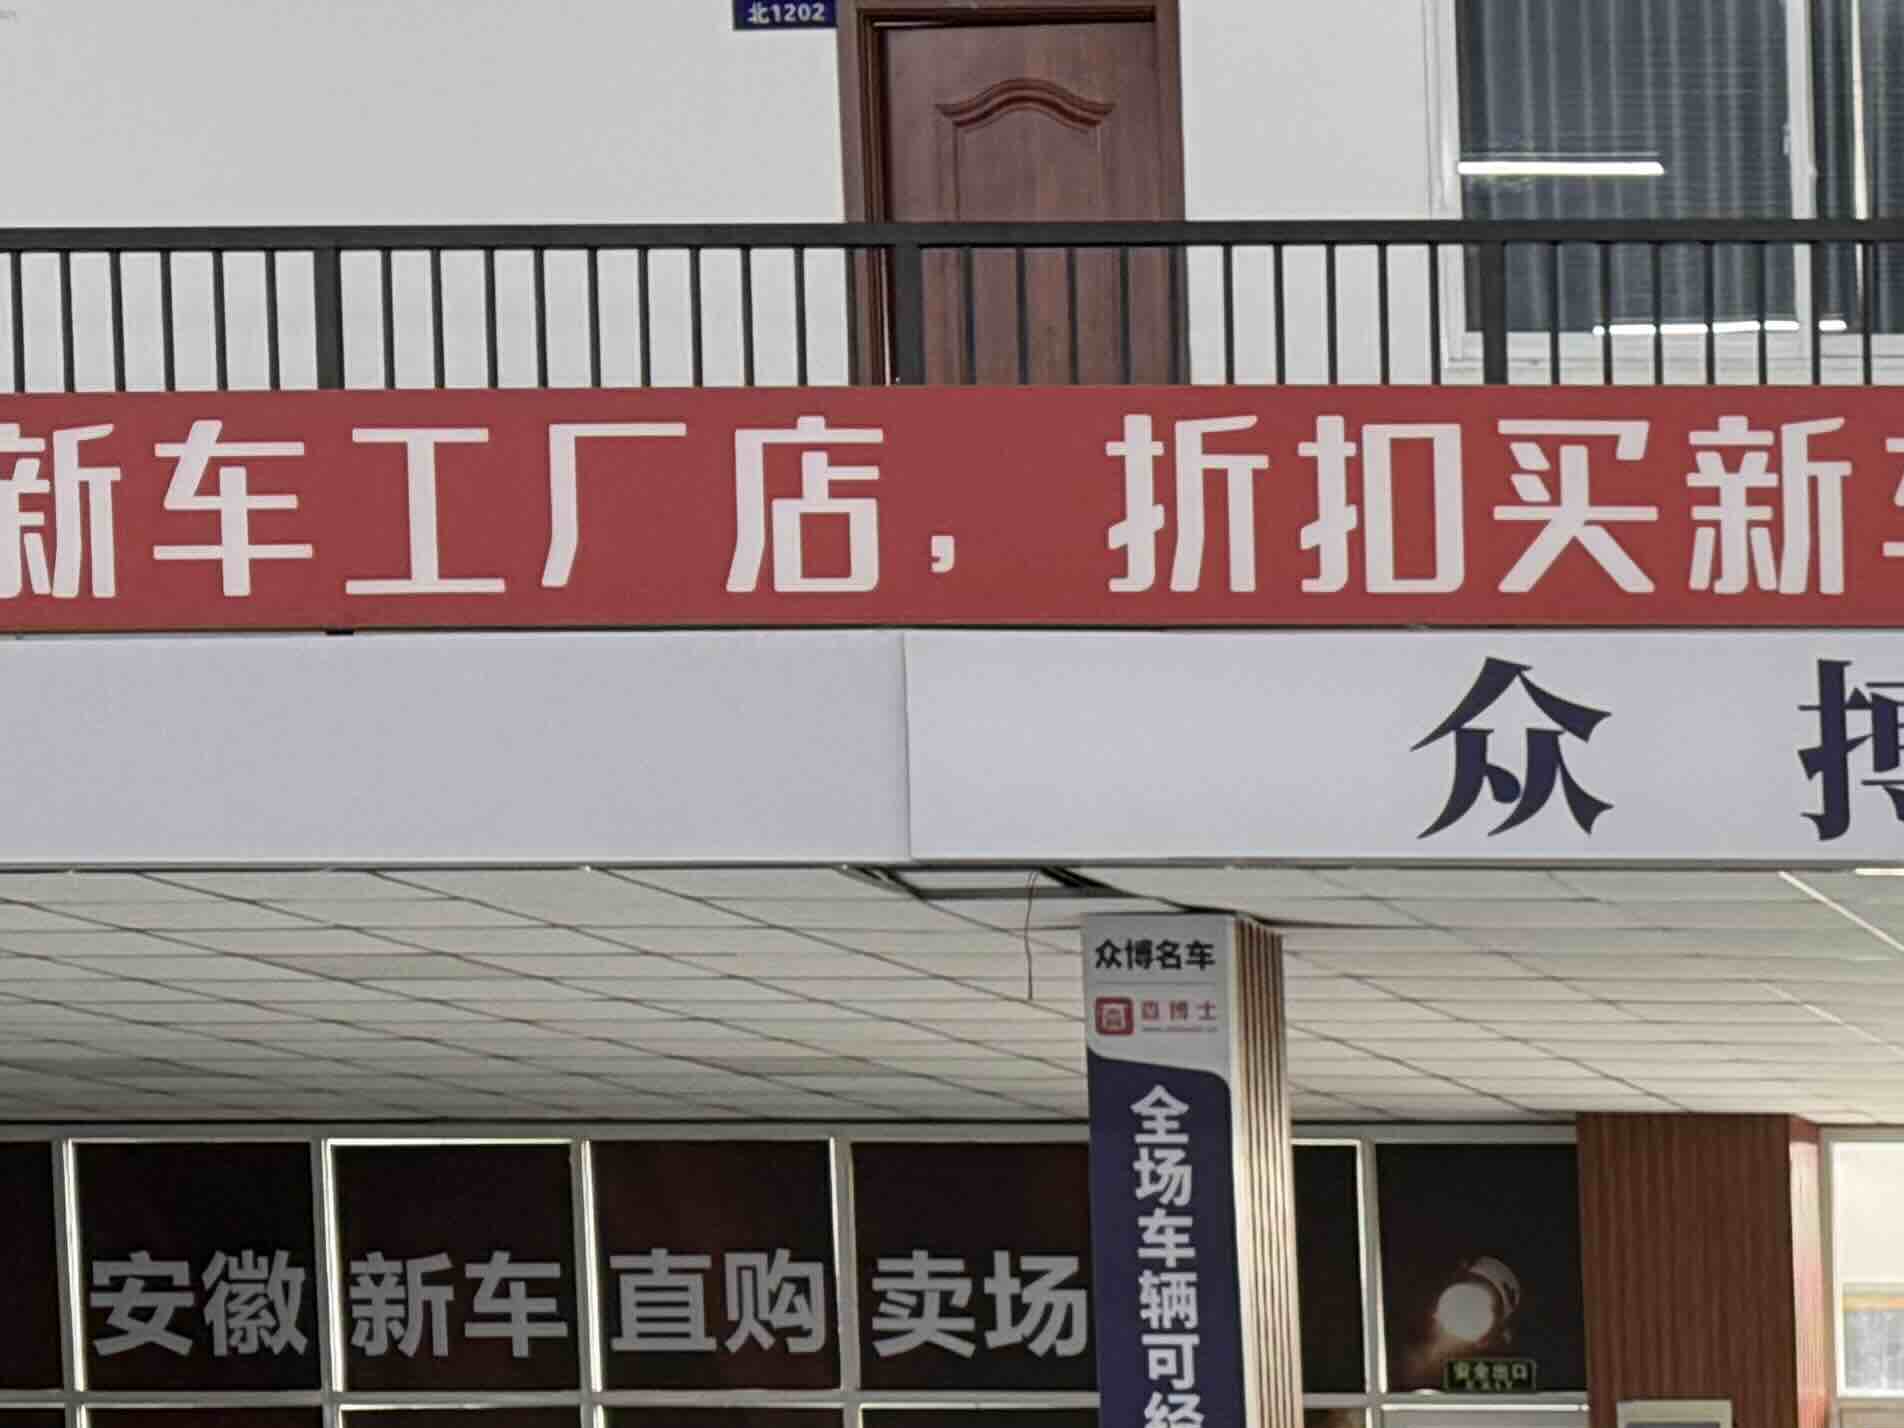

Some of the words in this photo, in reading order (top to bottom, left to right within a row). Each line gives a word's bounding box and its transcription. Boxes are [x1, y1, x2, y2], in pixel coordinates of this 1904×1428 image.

[747, 2, 826, 24] 北1202
[1095, 937, 1217, 971] 众博名车
